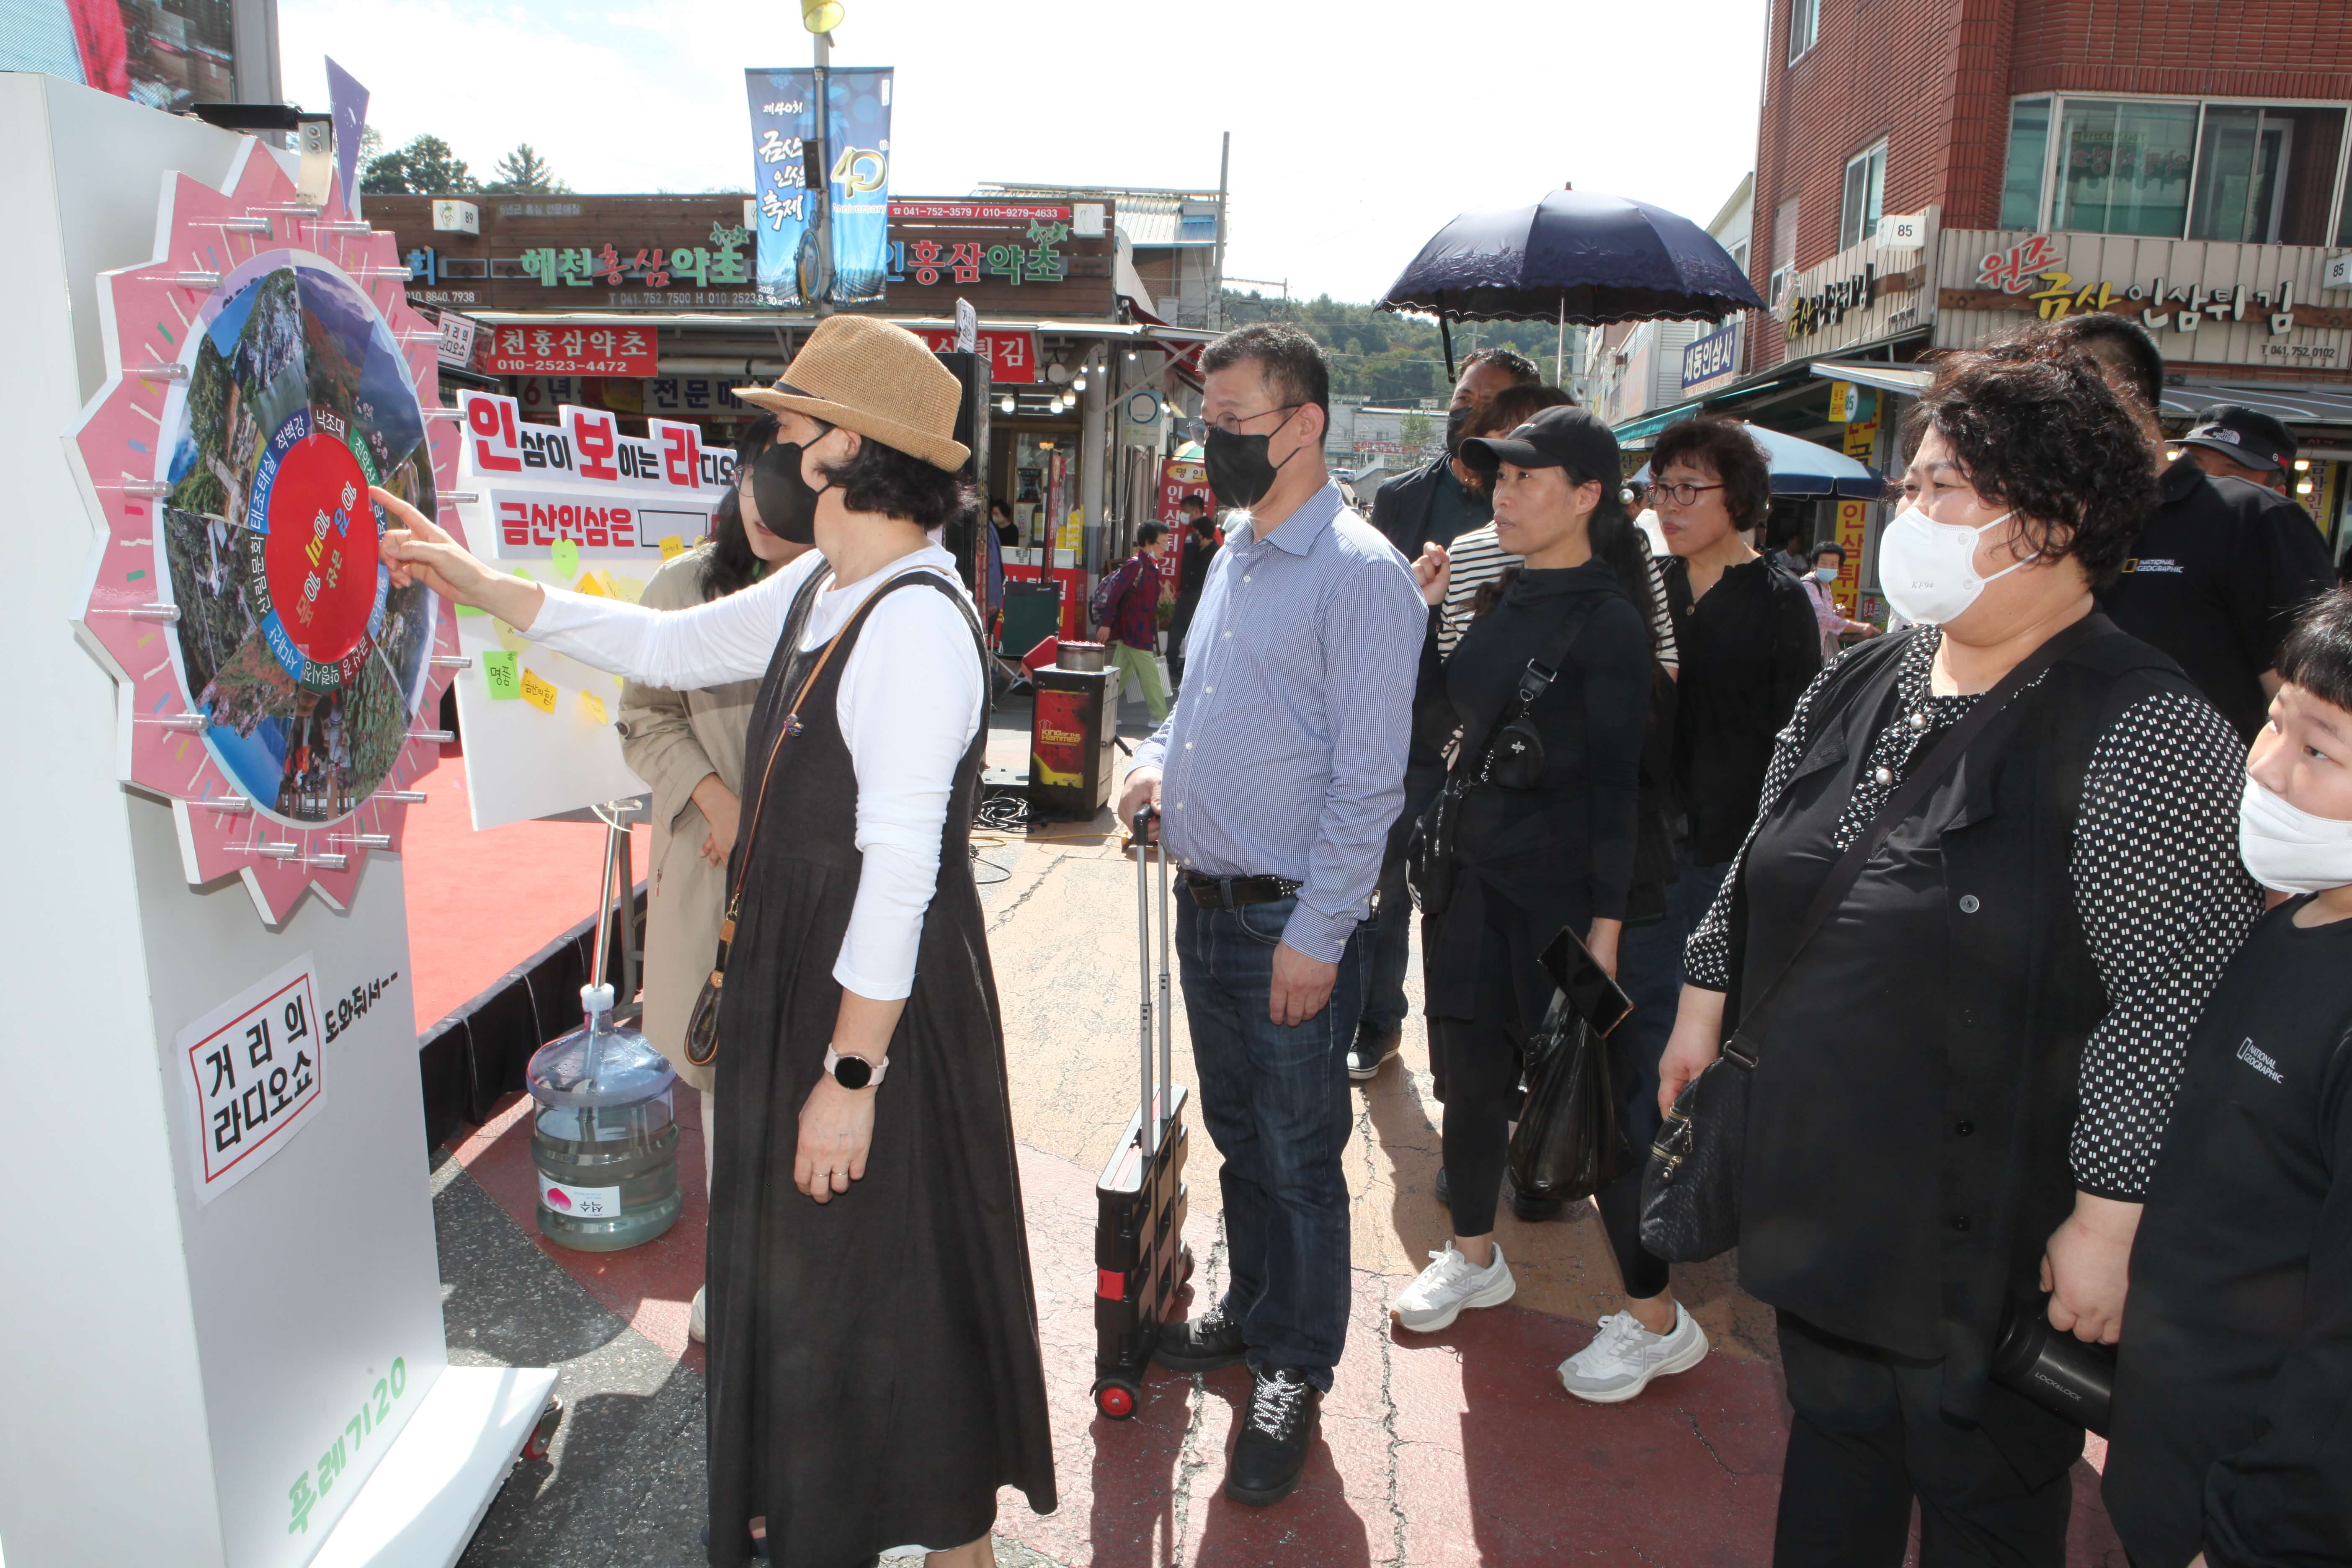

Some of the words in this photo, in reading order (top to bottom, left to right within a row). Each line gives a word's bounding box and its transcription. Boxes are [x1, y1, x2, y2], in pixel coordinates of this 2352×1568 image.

[763, 101, 803, 116] 제40회
[465, 211, 474, 224] 89
[761, 190, 804, 231] 축제
[831, 202, 887, 214] Anniversary
[903, 206, 972, 217] 041-752-3579
[983, 209, 1057, 218] 010-9279-4633
[1898, 224, 1913, 237] 85
[521, 243, 747, 287] 해천홍삼약초
[1975, 235, 2066, 294] 원조
[2332, 263, 2344, 278] 85
[758, 285, 774, 294] 2022
[491, 328, 648, 358] 천홍삼약초
[1684, 331, 1733, 382] 세동인삼사
[498, 359, 627, 372] 010-2523-4472
[275, 415, 305, 449] 적벽강
[316, 409, 345, 439] 낙조대
[467, 397, 573, 472] 인삼이
[574, 413, 660, 481] 보이는
[355, 437, 376, 486] 진악산
[251, 451, 277, 529] 태조태실
[500, 502, 635, 547] 금산인삼은
[250, 535, 272, 614] 산림문화
[268, 623, 298, 670] 서대산
[304, 661, 339, 685] 약령시장
[2244, 1054, 2285, 1084] GEOGRAPHIC
[2249, 1044, 2276, 1069] NATIONAL
[214, 1050, 313, 1153] 라디오쇼
[2034, 1372, 2082, 1402] LOCK&LOCK
